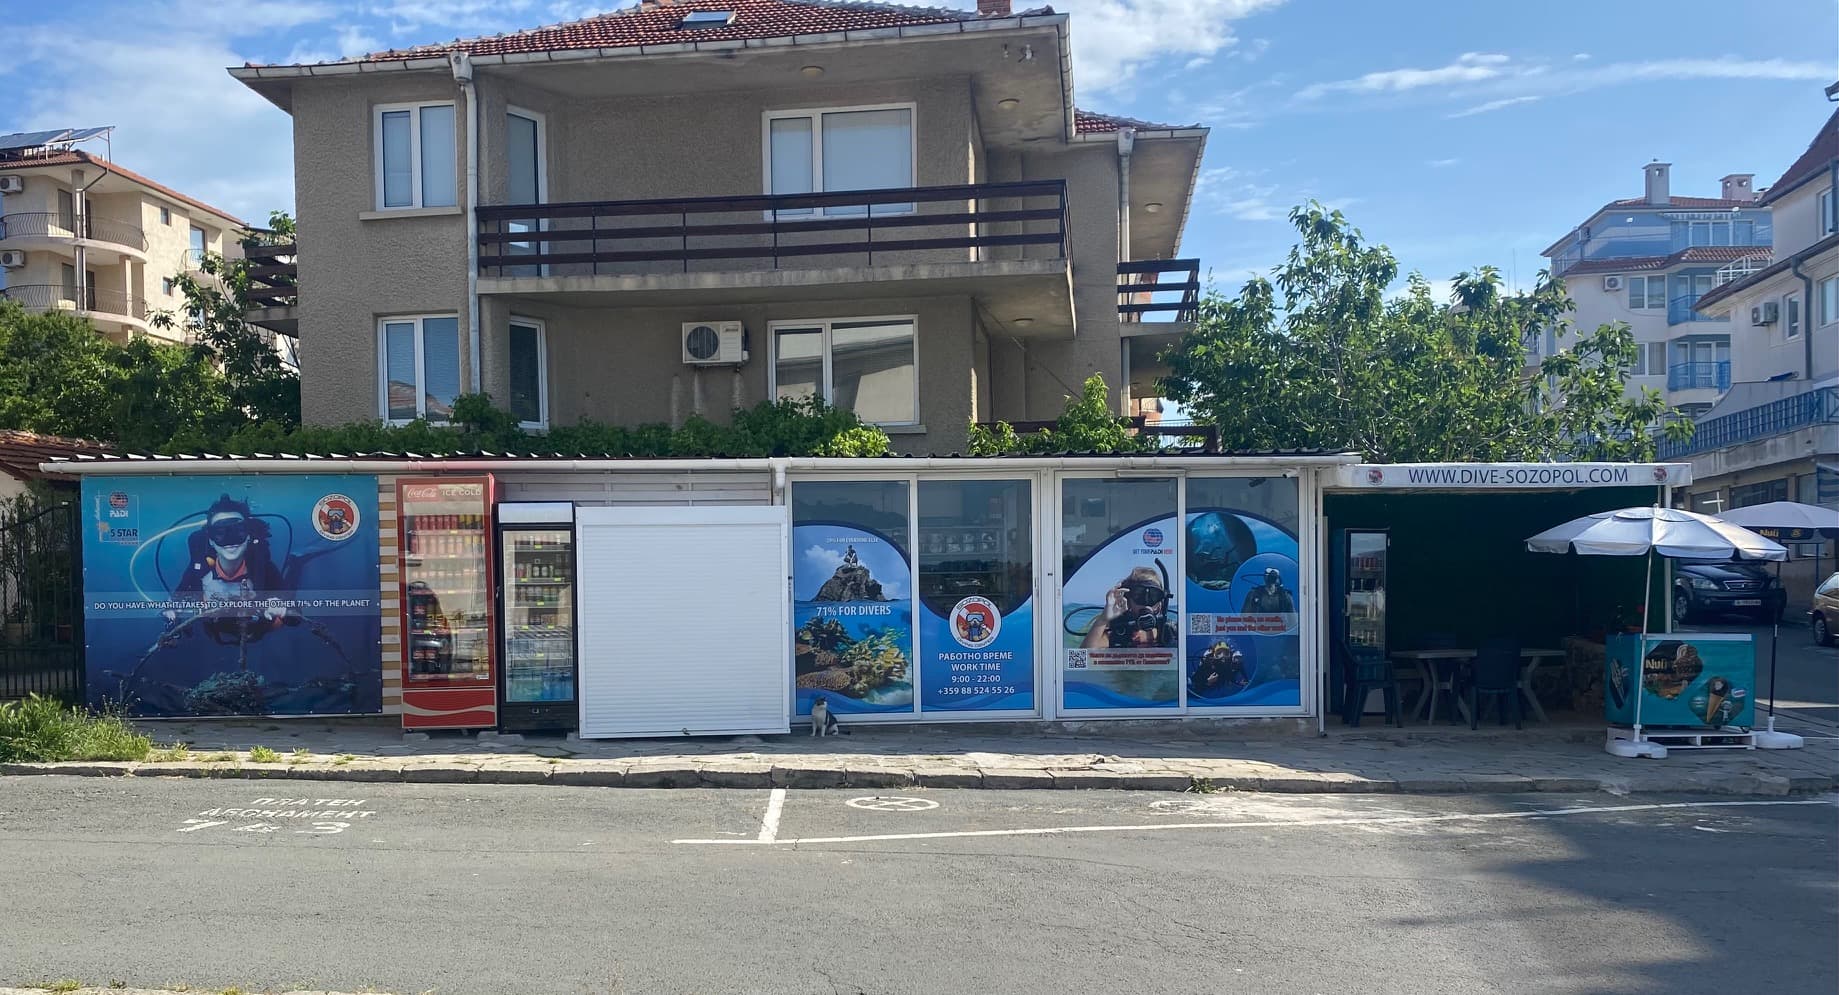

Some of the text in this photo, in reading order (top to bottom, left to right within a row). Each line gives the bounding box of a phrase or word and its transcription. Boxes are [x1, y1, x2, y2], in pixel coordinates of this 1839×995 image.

[1408, 468, 1629, 484] WWW.DIVE-SOZOPOL.COM
[442, 488, 456, 496] ICE
[459, 487, 482, 496] COLD
[109, 510, 129, 518] PADI
[117, 529, 138, 537] STAR
[94, 602, 106, 610] DO
[108, 602, 124, 610] YOU
[126, 602, 146, 610] HAVE
[182, 601, 205, 609] TAKES
[207, 601, 217, 609] TO
[219, 601, 253, 609] EXPLORE
[255, 601, 269, 609] THE
[313, 600, 323, 608] OF
[325, 600, 340, 608] THE
[341, 600, 370, 608] PLANET
[816, 605, 892, 616] 71% FOR DIVERS
[938, 651, 1013, 660] РАБОТНО ВРЕМЕ
[951, 663, 1001, 671] WORK TIME
[951, 675, 970, 683] 9:00
[977, 675, 1001, 683] 22:00
[937, 686, 1015, 695] +359 88 524 55 26
[251, 797, 367, 806] ПЛАТЕН
[199, 807, 377, 819] АБОНАМЕНТ
